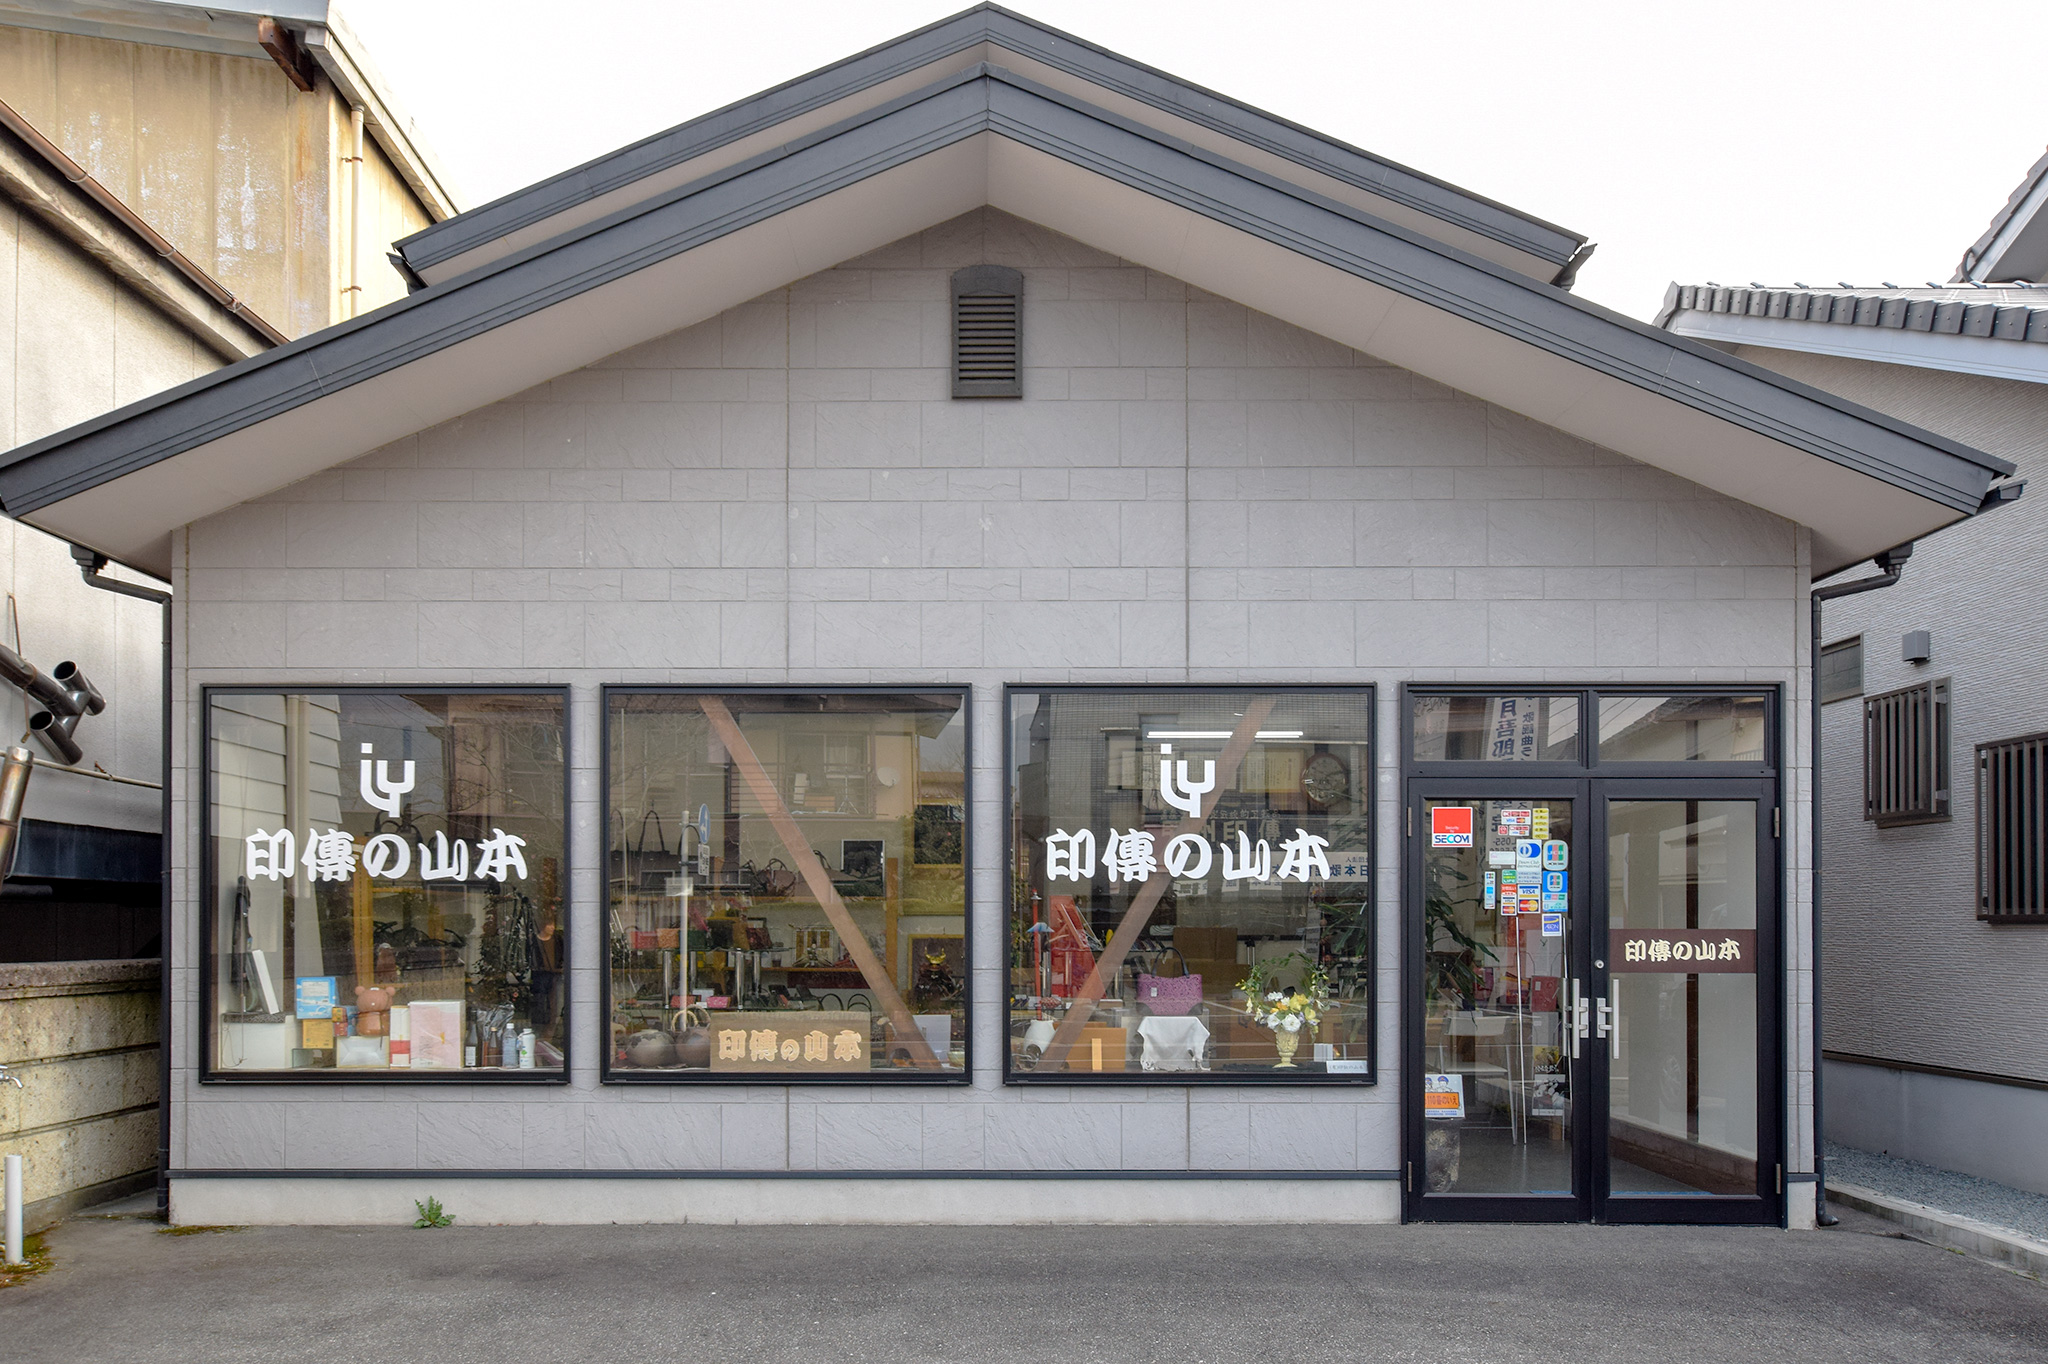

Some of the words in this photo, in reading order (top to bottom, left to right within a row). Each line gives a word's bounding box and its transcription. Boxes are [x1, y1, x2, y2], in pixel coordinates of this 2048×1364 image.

[246, 828, 528, 882] 印傳の山本
[1046, 828, 1330, 882] 印傳の山本
[1434, 834, 1470, 844] SECOM
[1624, 938, 1741, 962] 印傳の山本
